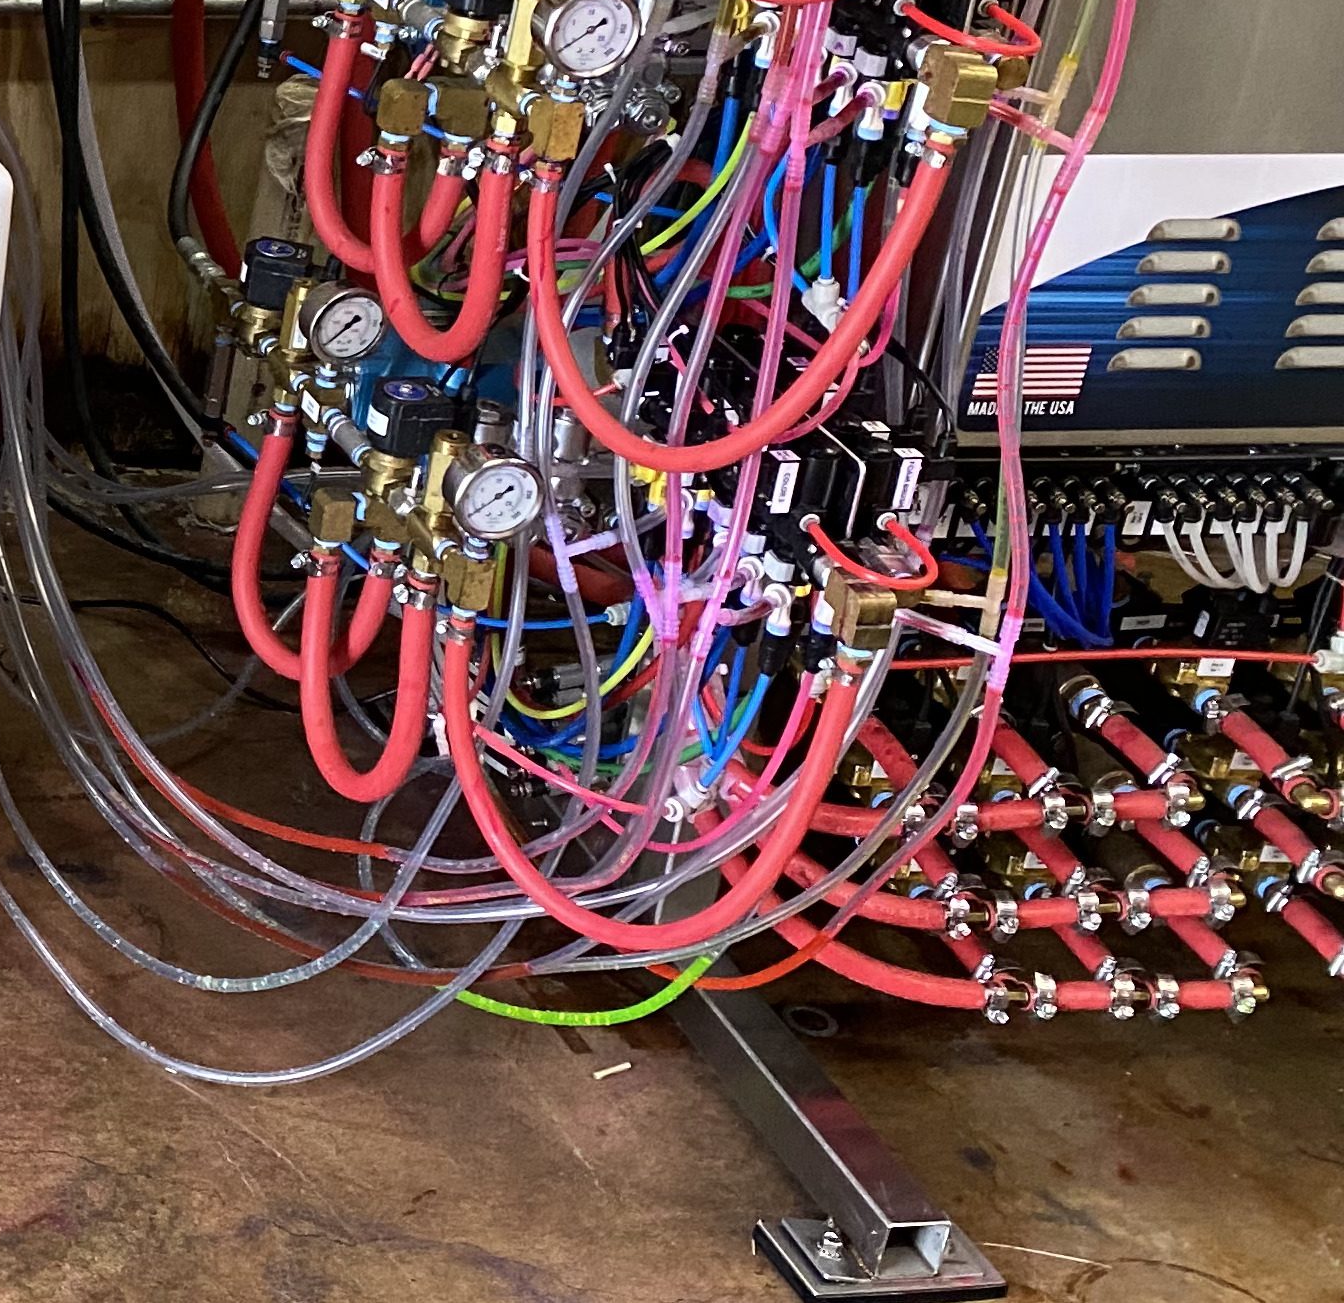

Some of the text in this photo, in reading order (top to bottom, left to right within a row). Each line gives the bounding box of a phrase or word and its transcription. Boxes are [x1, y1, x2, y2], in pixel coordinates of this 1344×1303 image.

[967, 400, 1074, 416] MAD THE USA
